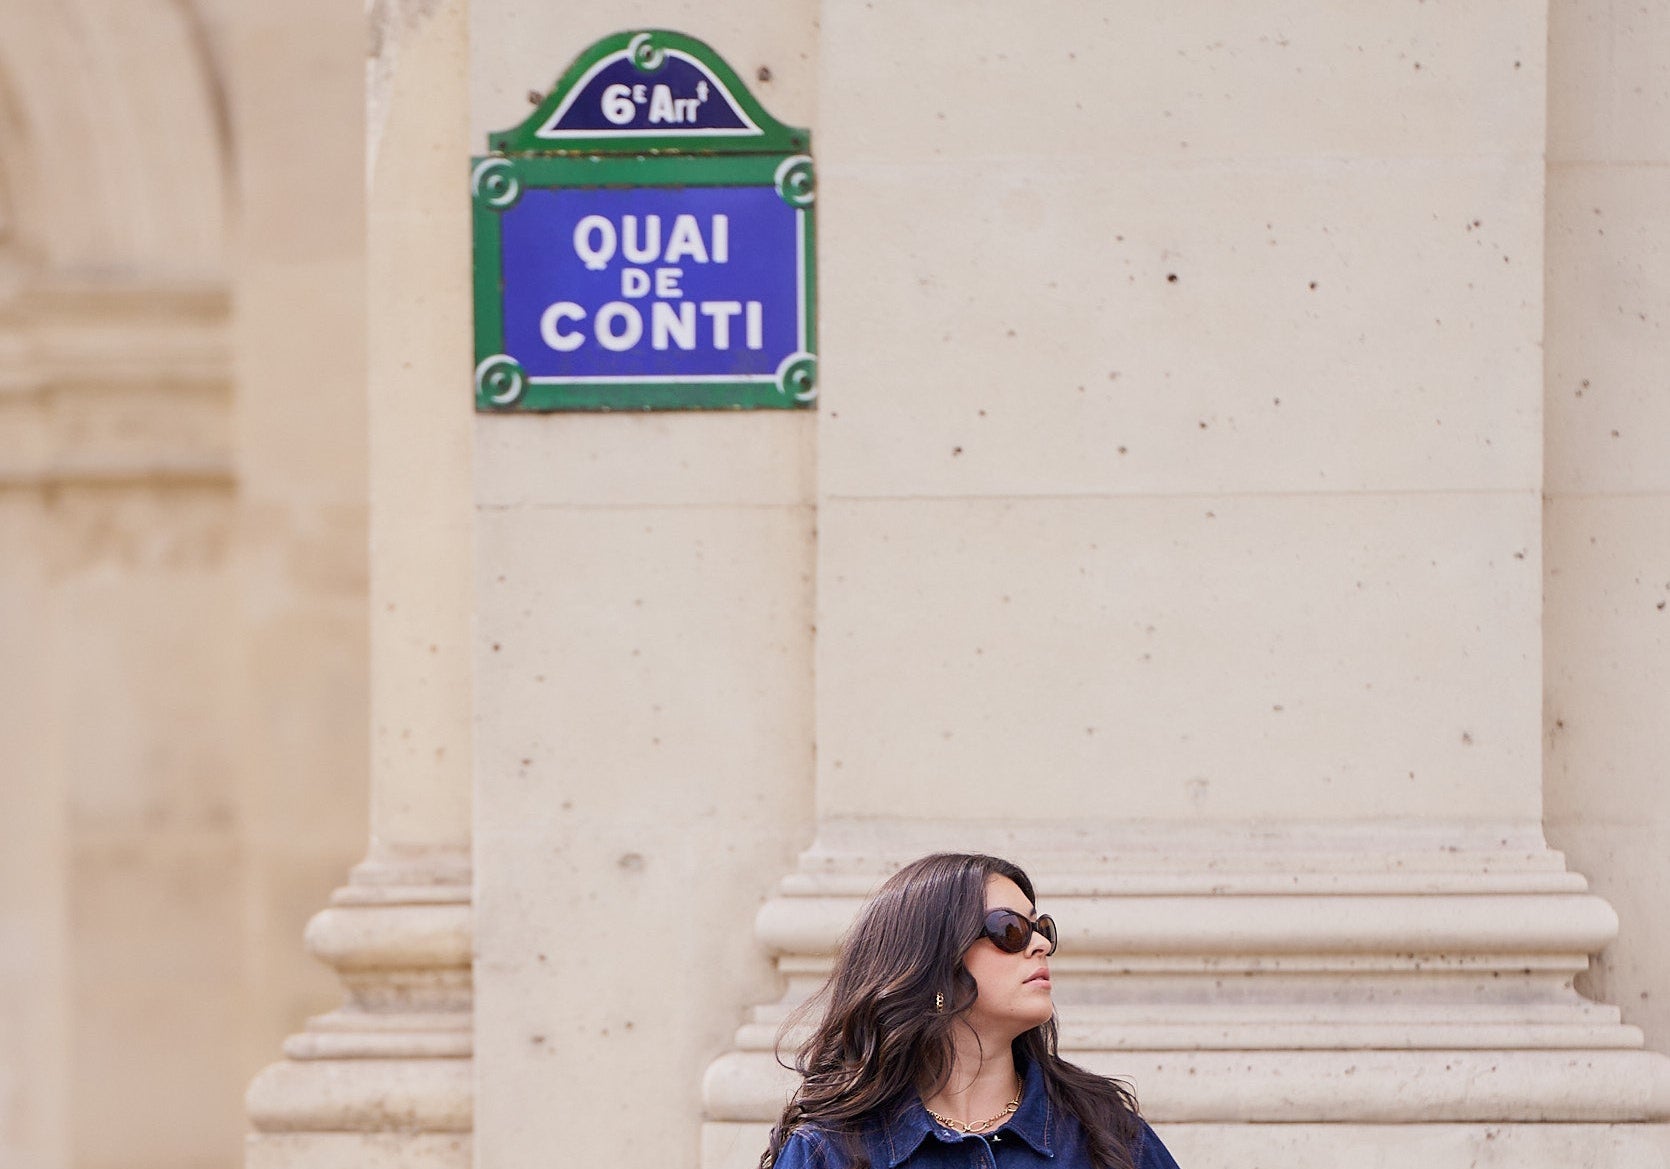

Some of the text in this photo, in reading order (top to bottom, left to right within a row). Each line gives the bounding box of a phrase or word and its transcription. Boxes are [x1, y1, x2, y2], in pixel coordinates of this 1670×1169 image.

[573, 214, 729, 270] QUAI
[621, 268, 683, 298] DE
[540, 300, 763, 351] CONTI
